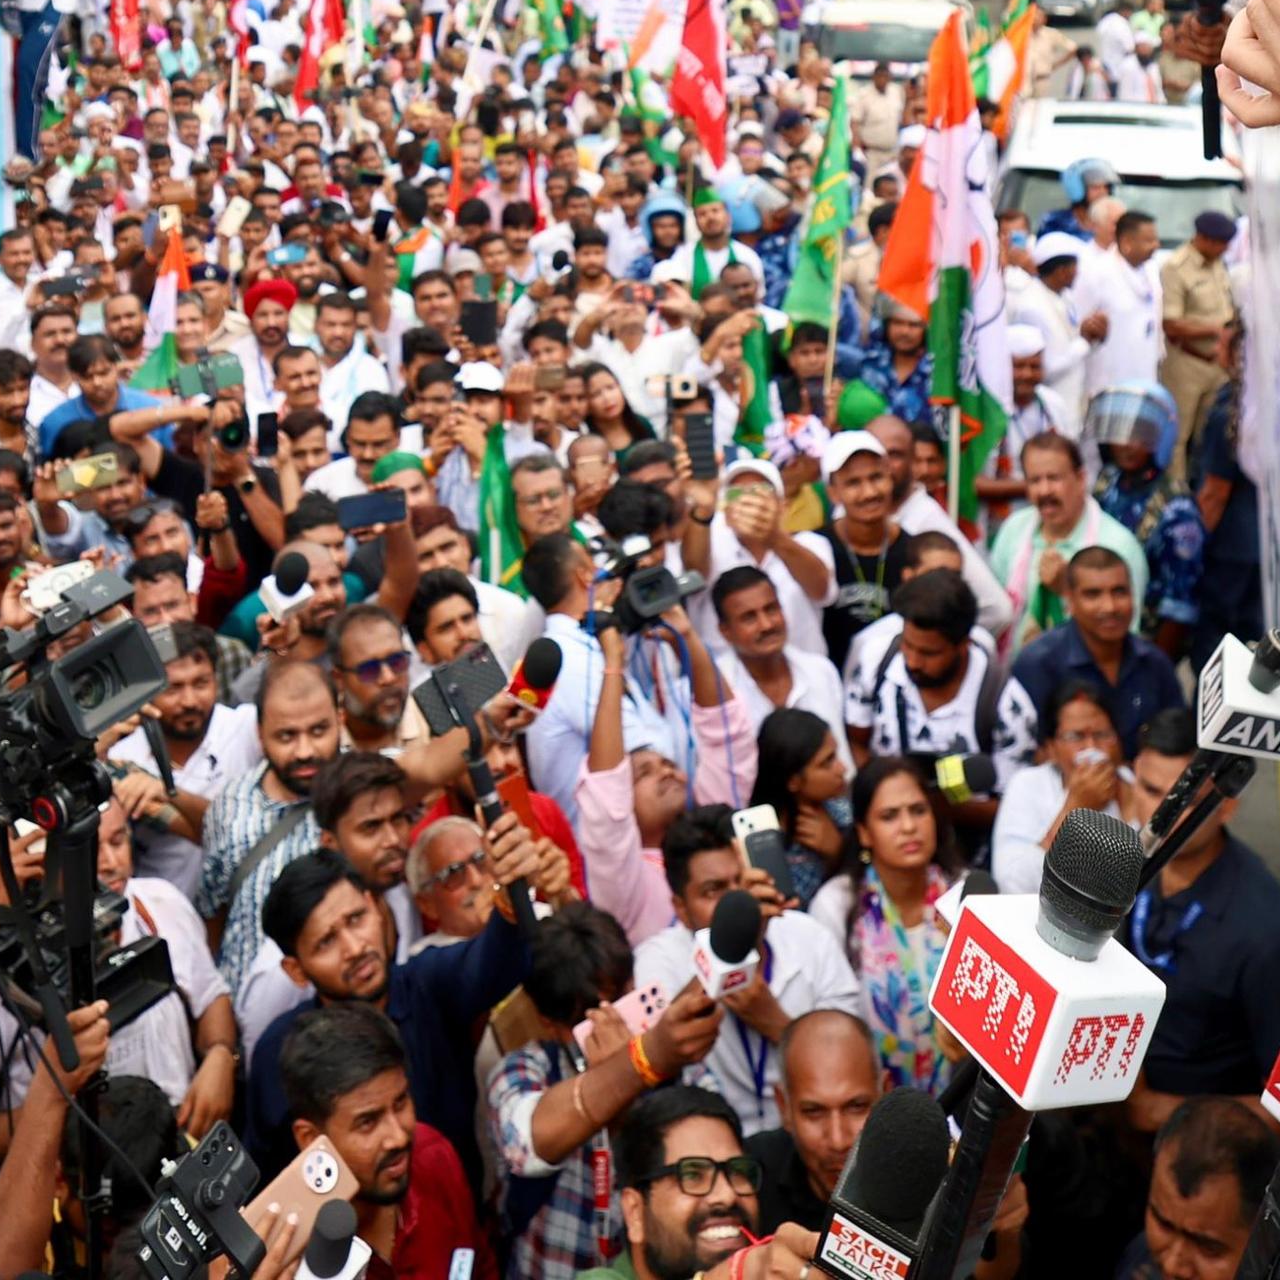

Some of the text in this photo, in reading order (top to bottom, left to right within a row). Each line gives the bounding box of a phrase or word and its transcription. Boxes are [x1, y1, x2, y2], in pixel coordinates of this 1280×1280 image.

[948, 935, 1037, 1065] PTI
[1053, 1012, 1146, 1085] PTI
[834, 1237, 895, 1280] TALKS
[838, 1225, 902, 1273] SACH
